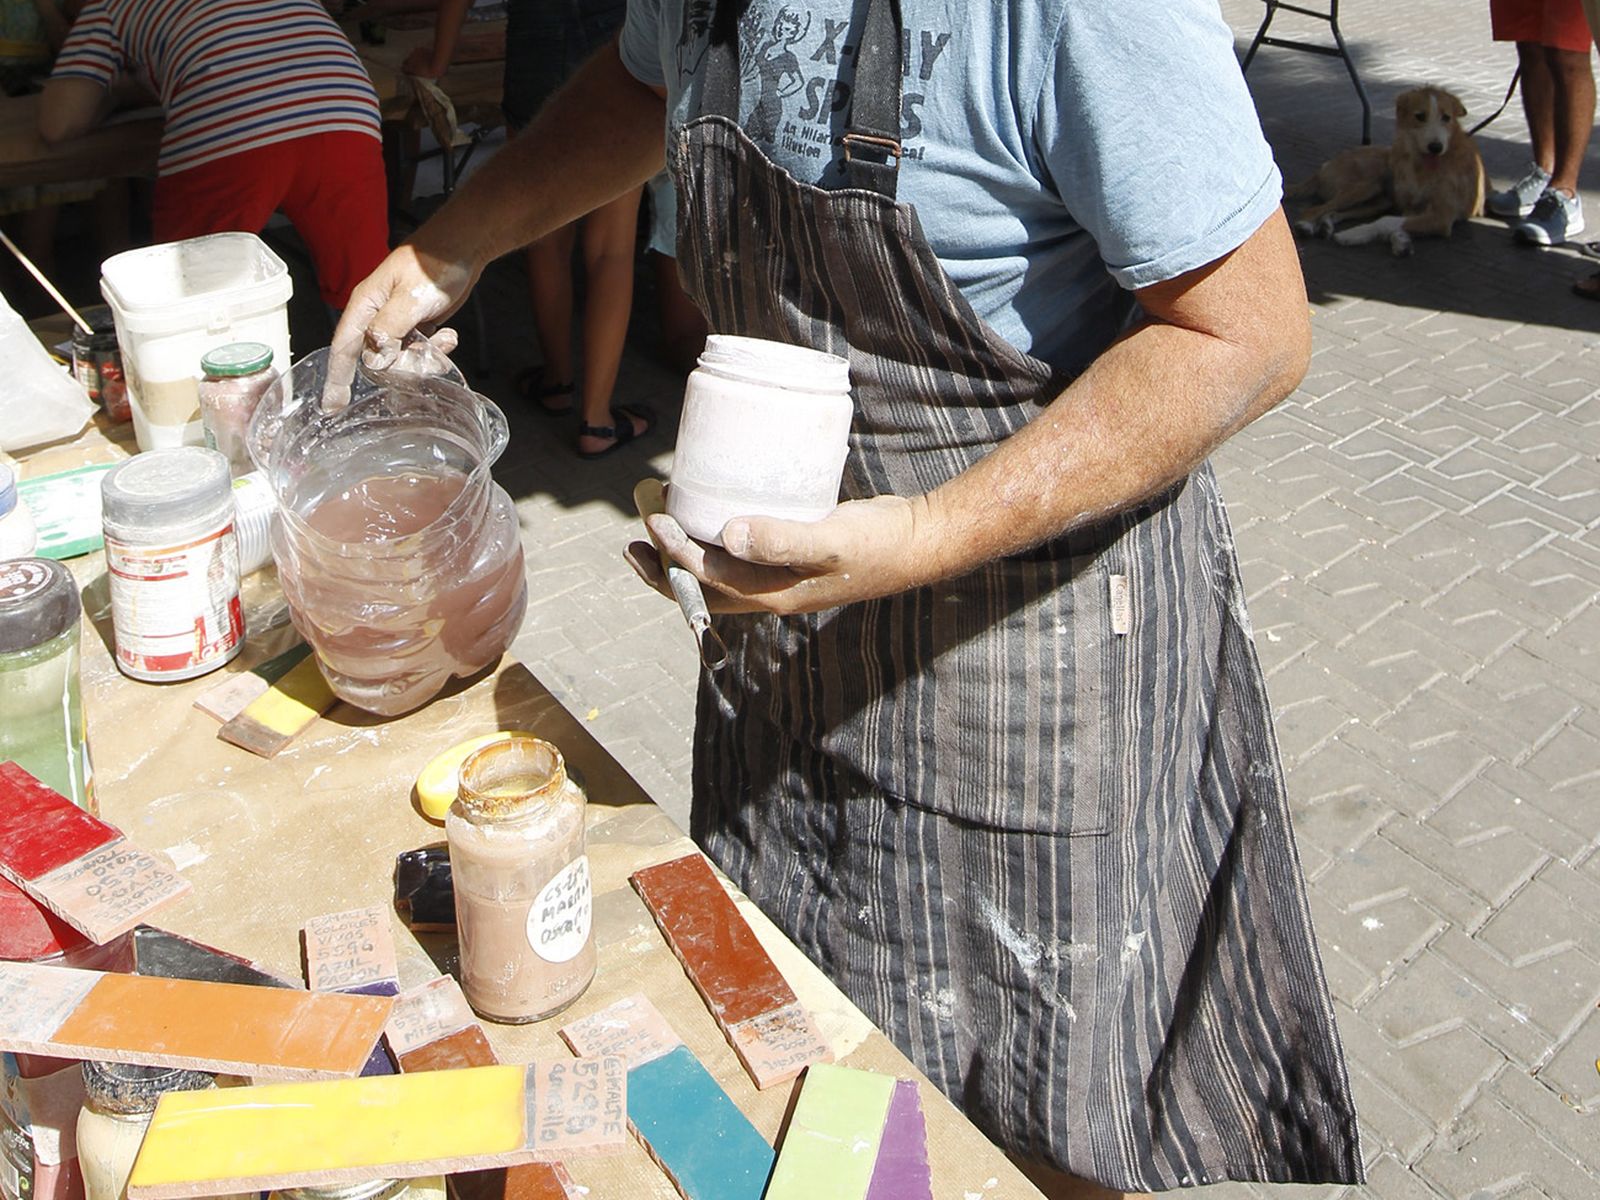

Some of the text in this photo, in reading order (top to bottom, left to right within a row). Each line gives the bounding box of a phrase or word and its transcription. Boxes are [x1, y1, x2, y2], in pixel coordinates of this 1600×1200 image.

[809, 18, 952, 81] X-Y
[798, 76, 925, 140] SPS
[403, 1019, 450, 1042] MIEL
[603, 1058, 621, 1135] ESMALTE
